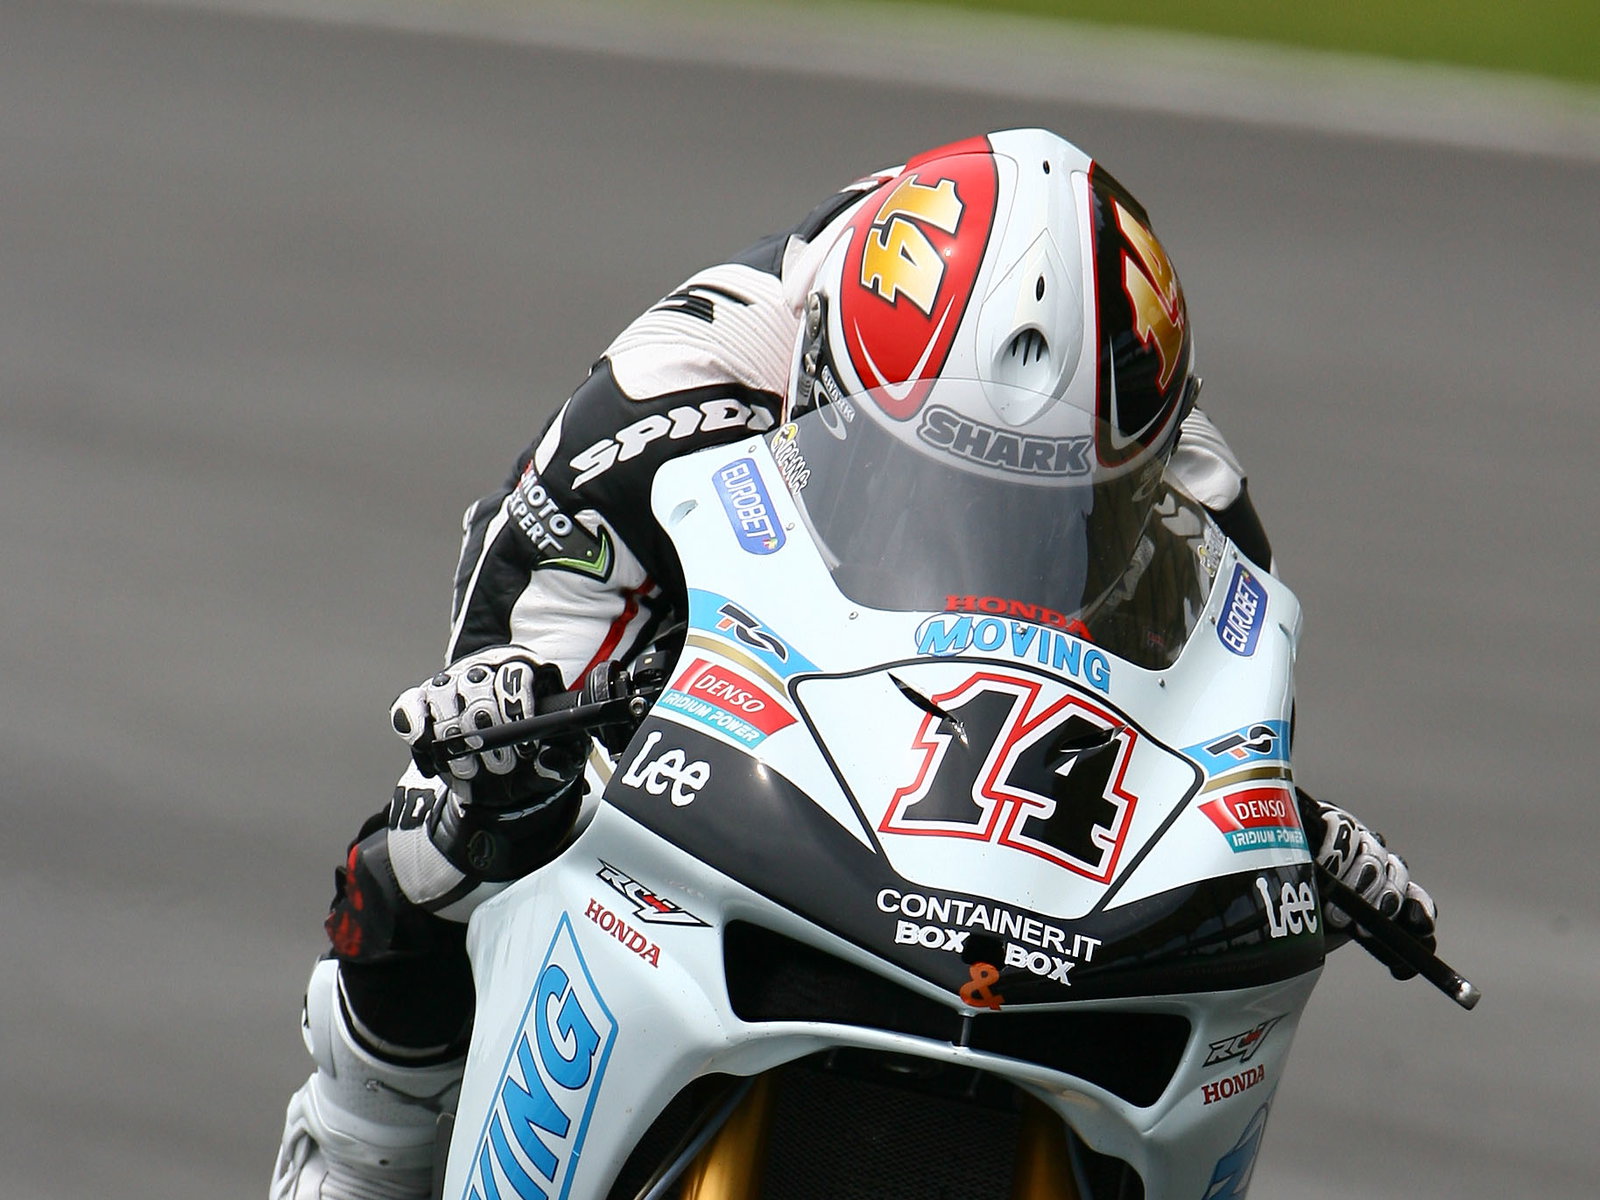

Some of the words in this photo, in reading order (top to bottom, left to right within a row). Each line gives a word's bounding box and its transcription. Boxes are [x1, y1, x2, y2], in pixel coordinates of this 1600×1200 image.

[859, 173, 967, 317] 14
[569, 398, 775, 490] SPIDI
[916, 404, 1094, 477] SHARK
[520, 469, 573, 537] MOTO
[721, 463, 777, 539] EUROBET
[944, 595, 1097, 642] HONDA
[1222, 575, 1260, 653] EUROBET
[915, 612, 1111, 694] MOVING
[694, 674, 766, 713] DENSO
[707, 711, 761, 743] POWER
[620, 730, 711, 807] Lee
[879, 672, 1139, 885] 14
[1232, 830, 1276, 847] IRIDIUM
[1234, 799, 1286, 820] DENSO
[584, 897, 664, 968] HONDA
[876, 888, 1102, 962] CONTAINER.IT
[894, 919, 971, 954] BOX
[1255, 876, 1318, 939] Lee
[958, 961, 1006, 1011] &
[1004, 942, 1075, 987] BOX
[1201, 1063, 1265, 1106] HONDA
